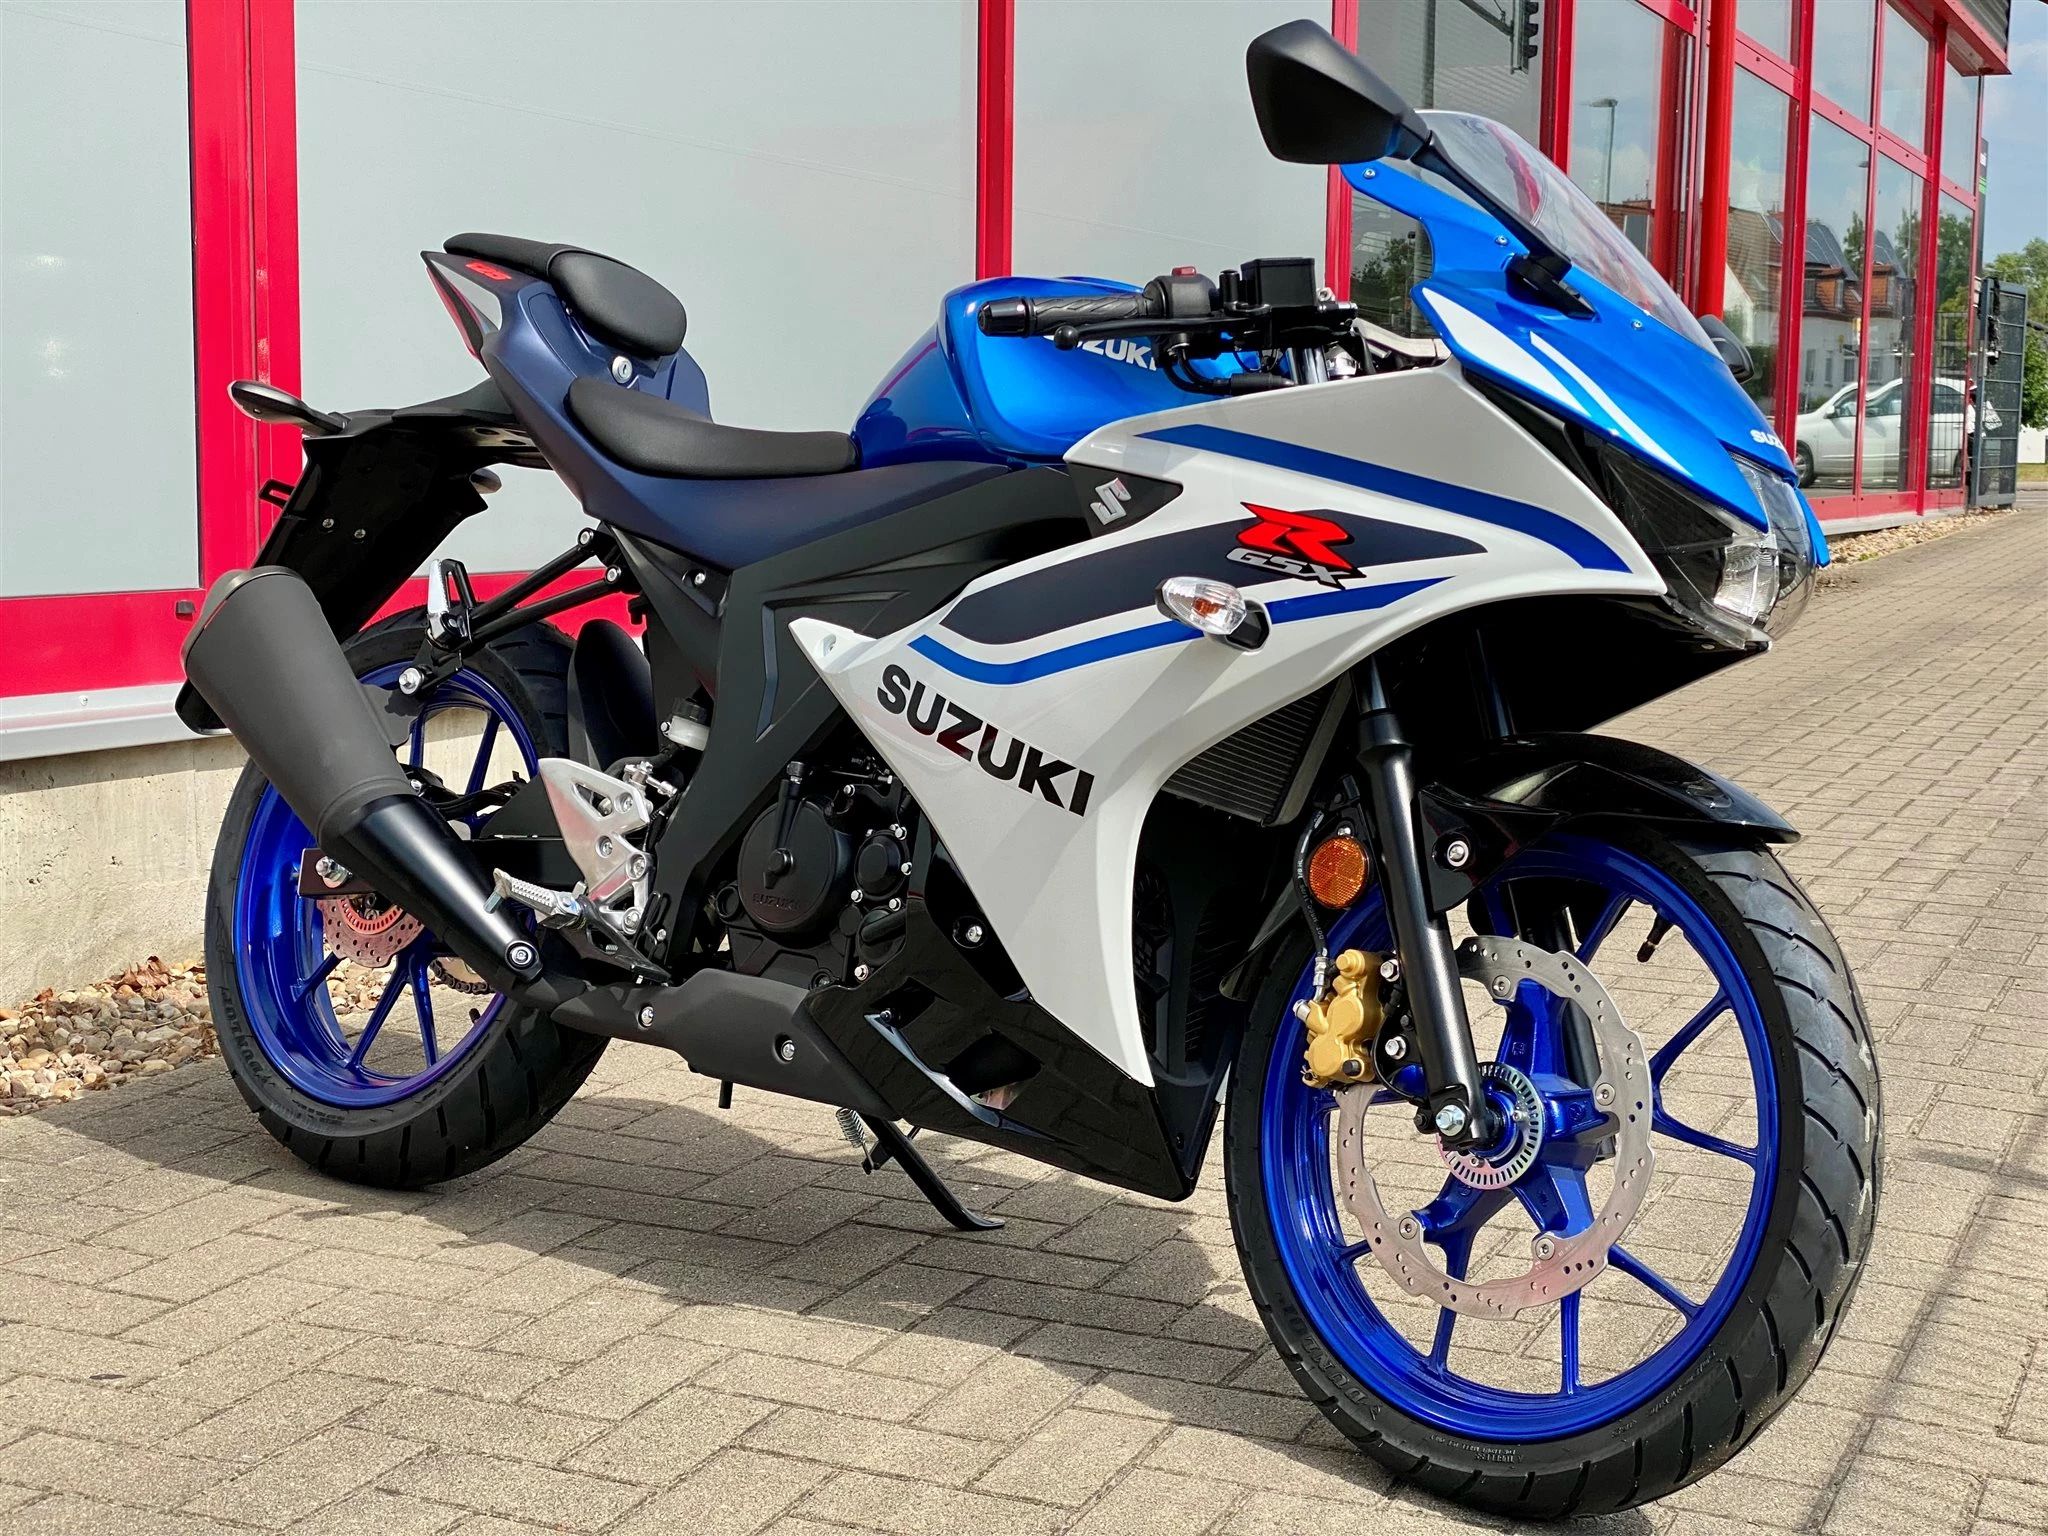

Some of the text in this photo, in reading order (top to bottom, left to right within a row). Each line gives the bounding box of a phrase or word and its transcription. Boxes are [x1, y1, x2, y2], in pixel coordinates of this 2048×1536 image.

[1227, 548, 1352, 589] GSX
[1236, 501, 1354, 570] R
[877, 664, 1095, 817] SUZUKI
